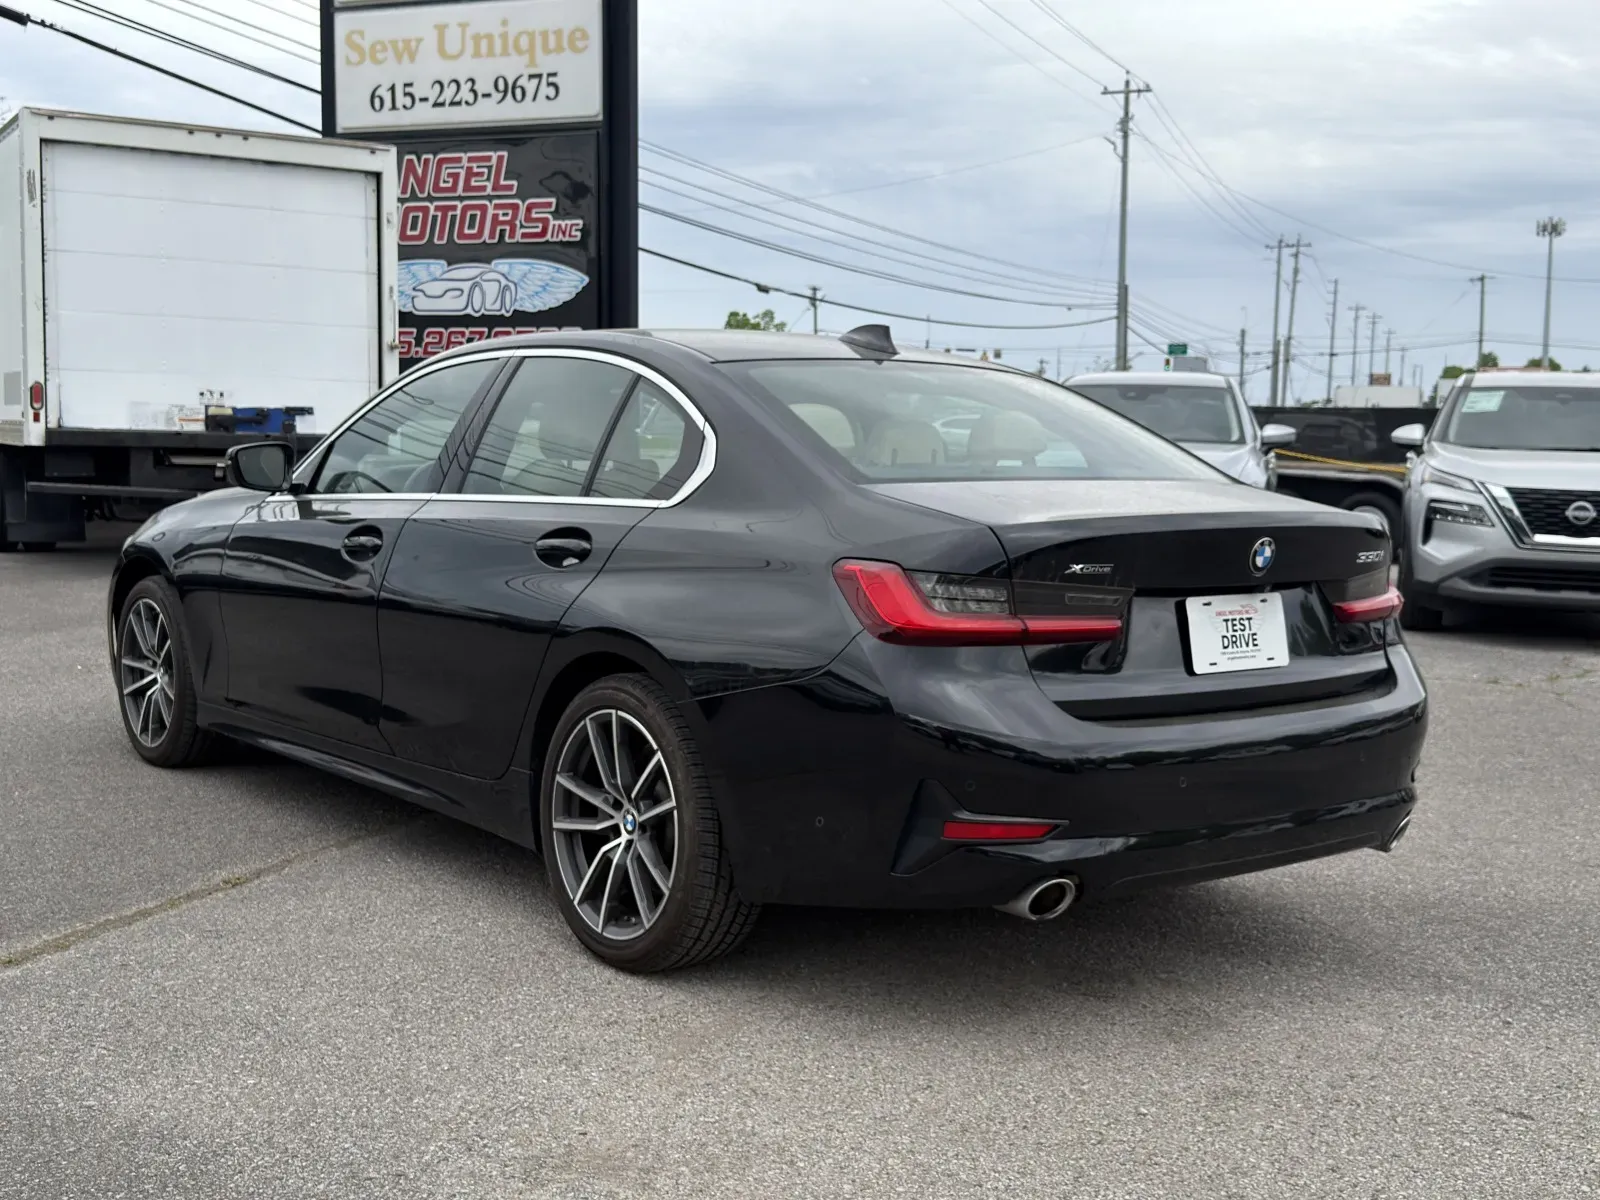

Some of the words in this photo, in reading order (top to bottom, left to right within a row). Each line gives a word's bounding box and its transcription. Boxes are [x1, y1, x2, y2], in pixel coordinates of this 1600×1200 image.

[344, 29, 424, 66] Sew
[433, 18, 590, 68] Unique
[369, 72, 561, 112] 615-223-9675
[399, 152, 517, 198] NGEL
[398, 198, 556, 244] OTORS
[550, 219, 583, 242] INC
[1221, 633, 1259, 649] DRIVE
[1222, 617, 1253, 633] TEST
